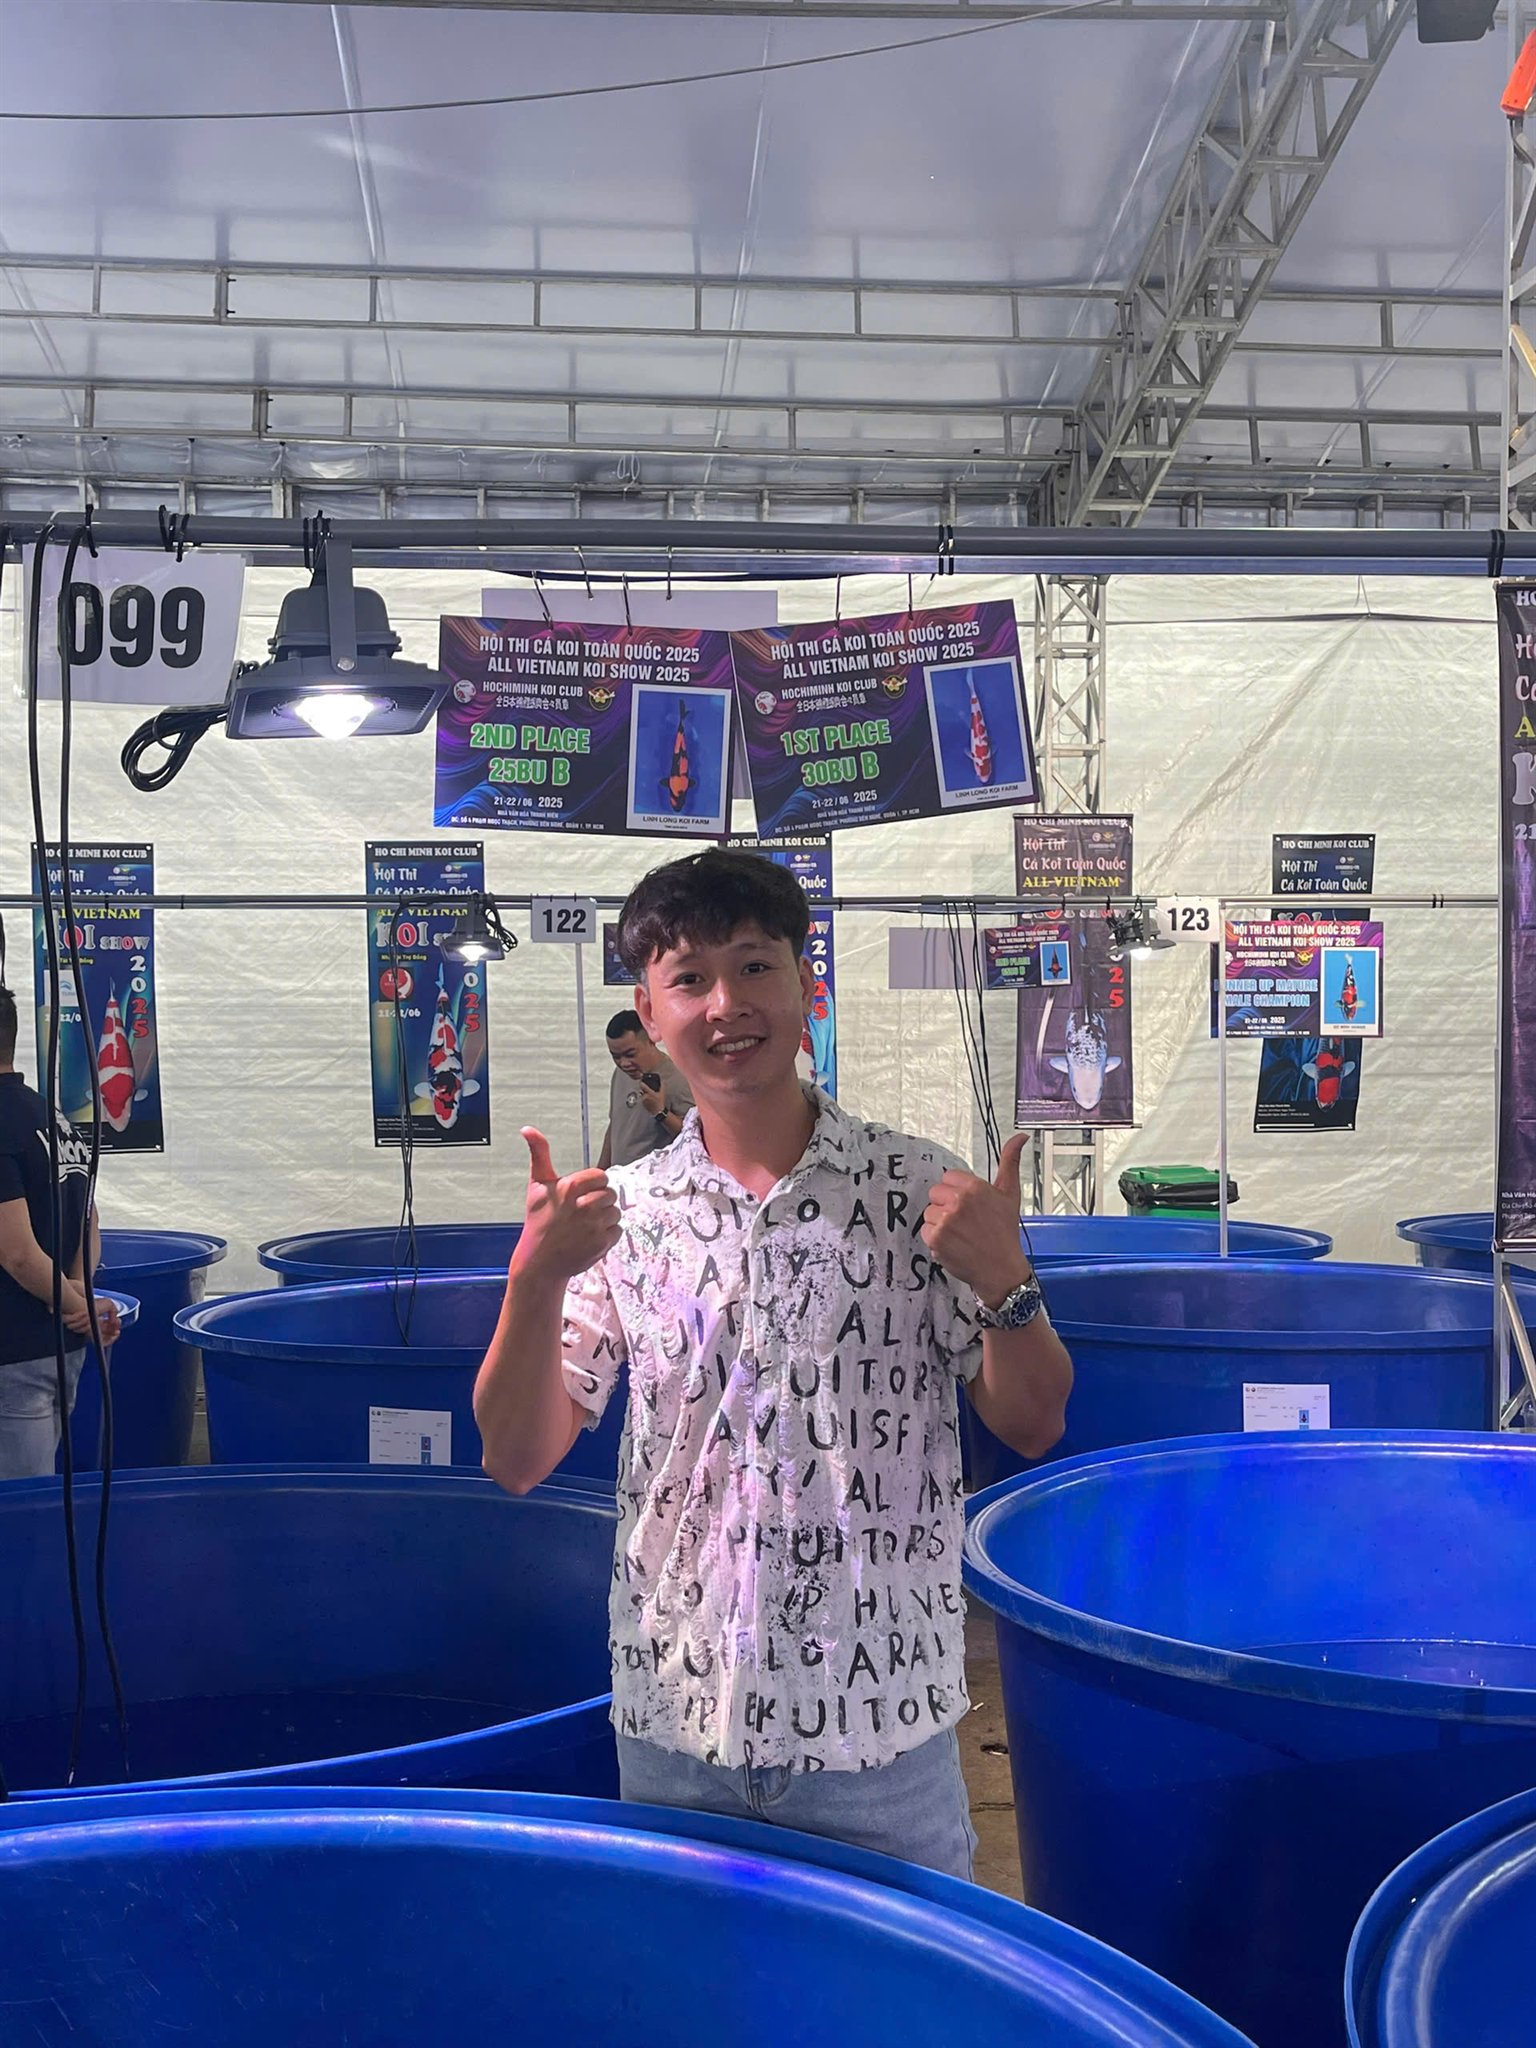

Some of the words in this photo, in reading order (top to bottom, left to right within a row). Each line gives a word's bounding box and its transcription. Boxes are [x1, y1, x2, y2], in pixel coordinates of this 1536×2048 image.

[58, 582, 205, 669] 099
[480, 635, 504, 655] HỘI
[508, 637, 529, 654] THI
[534, 636, 551, 655] CÁ
[557, 640, 579, 656] KOI
[583, 639, 620, 658] TOÀN
[624, 640, 661, 661] QUỐC
[666, 646, 700, 663] 2025
[771, 643, 794, 662] HỘI
[797, 641, 819, 656] THI
[822, 635, 840, 655] CÁ
[844, 634, 866, 652] KOI
[869, 629, 905, 648] TOÀN
[908, 621, 944, 645] QUỐC
[947, 621, 980, 639] 2025
[783, 663, 807, 679] ALL
[810, 657, 870, 676] VIETNAM
[873, 652, 895, 670] KOI
[899, 646, 938, 665] SHOW
[942, 642, 975, 660] 2025
[487, 657, 512, 673] ALL
[516, 658, 579, 676] VIETNAM
[583, 662, 606, 678] KOI
[610, 663, 652, 680] SHOW
[656, 666, 690, 683] 2025
[483, 681, 538, 695] HOCHIMINH
[540, 684, 557, 696] KOI
[559, 685, 583, 697] CLUB
[781, 684, 835, 700] HOCHIMINH
[837, 681, 852, 693] KOI
[855, 678, 878, 691] CLUB
[470, 722, 516, 749] 2ND
[521, 725, 591, 754] PLACE
[780, 727, 820, 756] 1ST
[824, 718, 892, 751] PLACE
[488, 757, 547, 785] 25BU
[552, 757, 570, 786] B
[801, 756, 858, 788] 30BU
[860, 751, 880, 780] B
[538, 797, 563, 808] 2025
[853, 789, 878, 803] 2025
[727, 839, 740, 848] HO
[741, 838, 758, 848] CHI
[785, 837, 802, 846] KOI
[802, 837, 827, 846] CLUB
[1282, 840, 1296, 849] HO
[1297, 840, 1313, 849] CHI
[1314, 840, 1332, 849] MINH
[1333, 840, 1347, 849] KOI
[1348, 840, 1370, 849] CLUB
[75, 849, 101, 858] MINH
[102, 849, 120, 858] KOI
[121, 849, 148, 859] CLUB
[374, 847, 389, 857] HO
[390, 847, 407, 857] CHI
[408, 847, 433, 857] MINH
[435, 847, 452, 856] KOI
[453, 847, 478, 857] CLUB
[1023, 876, 1050, 887] ALL
[1053, 876, 1121, 888] VIETNAM
[1281, 878, 1295, 891] Cá
[1296, 878, 1312, 891] Koi
[542, 908, 586, 933] 122
[1167, 907, 1210, 931] 123
[1249, 925, 1262, 935] THI
[1264, 924, 1276, 935] CÁ
[1278, 925, 1291, 935] KOI
[1341, 925, 1361, 935] 2025
[99, 936, 150, 951] SHOW
[1238, 937, 1253, 946] ALL
[1255, 937, 1291, 946] VIETNAM
[1293, 937, 1307, 946] KOI
[1308, 937, 1334, 946] SHOW
[1335, 937, 1356, 946] 2025
[1259, 978, 1275, 992] UP
